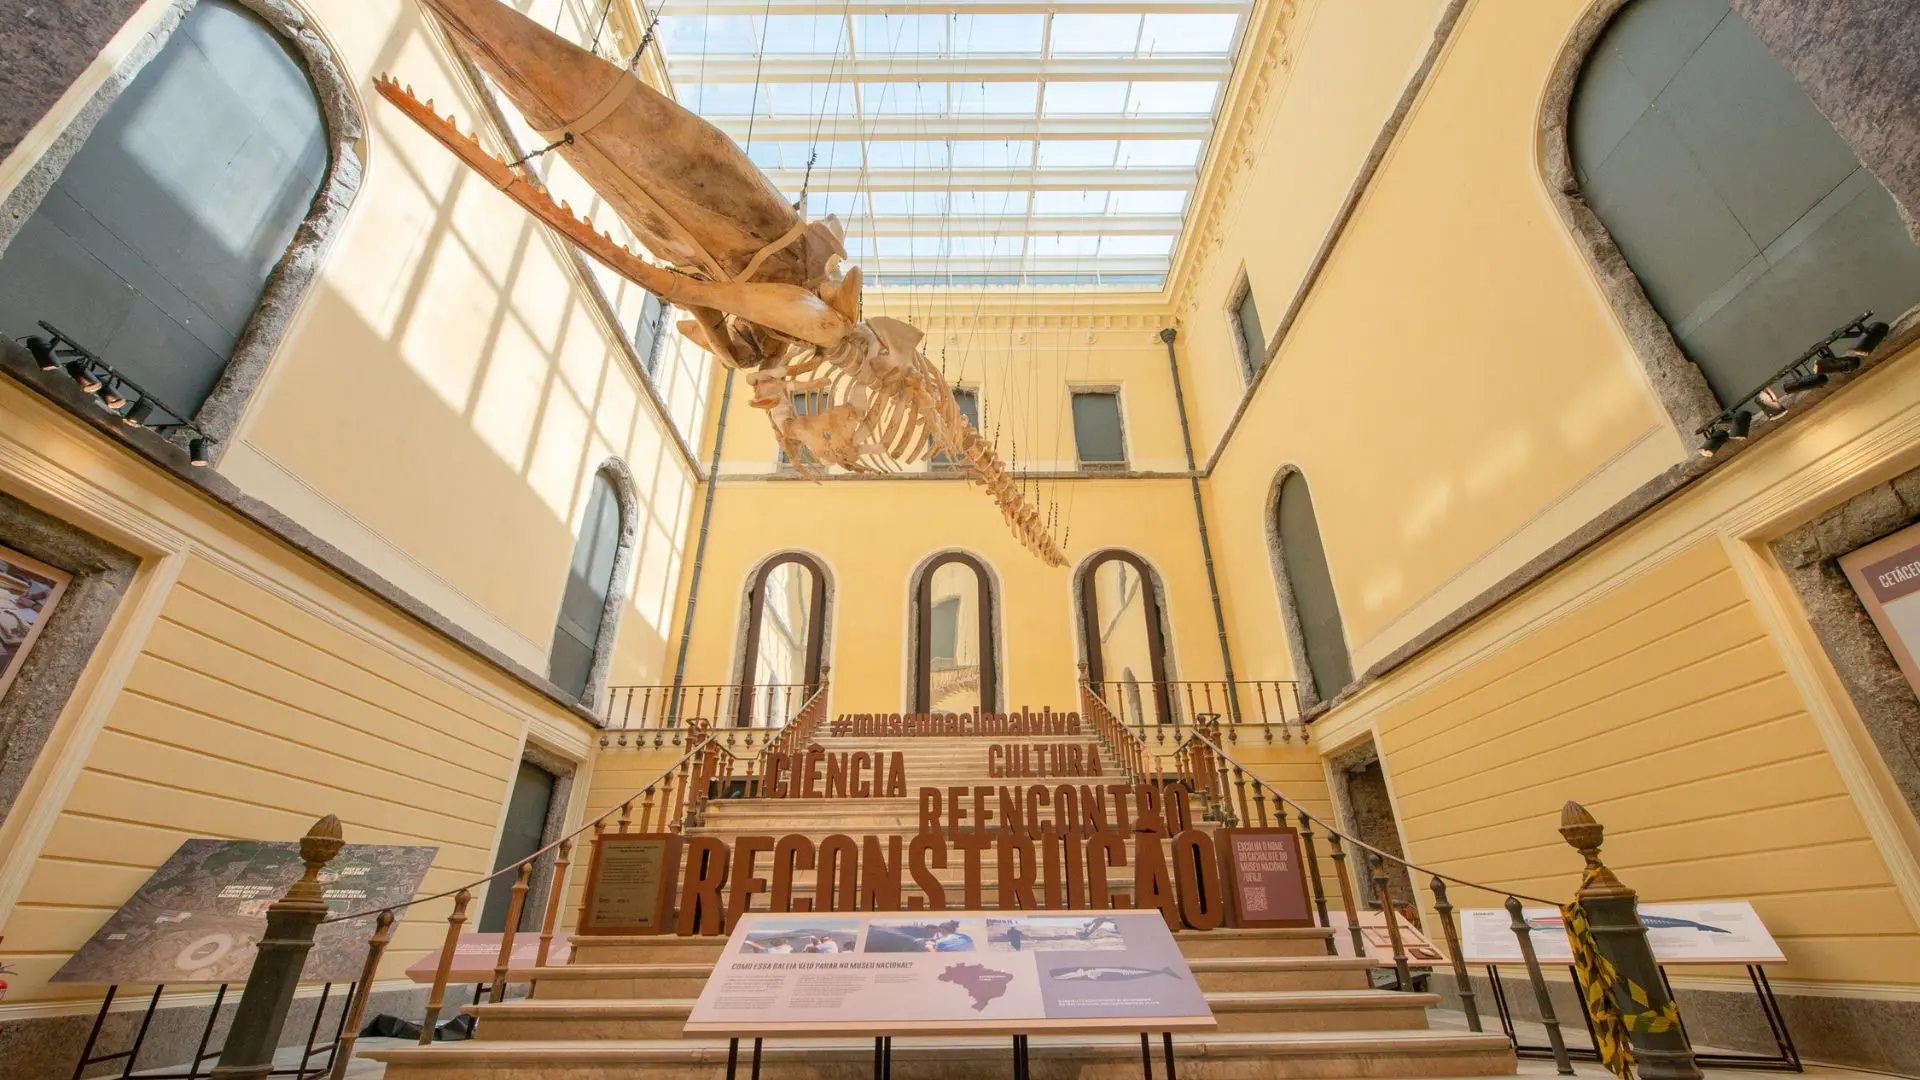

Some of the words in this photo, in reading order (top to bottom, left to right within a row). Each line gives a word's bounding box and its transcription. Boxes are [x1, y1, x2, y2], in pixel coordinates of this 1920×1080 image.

[830, 705, 1082, 737] #museunacionalvive
[766, 743, 907, 798] CIÊNCIA
[988, 744, 1103, 777] CULTURA
[919, 783, 1193, 841] REENCONTRO
[677, 817, 1223, 937] RECONSTRUÇÃO
